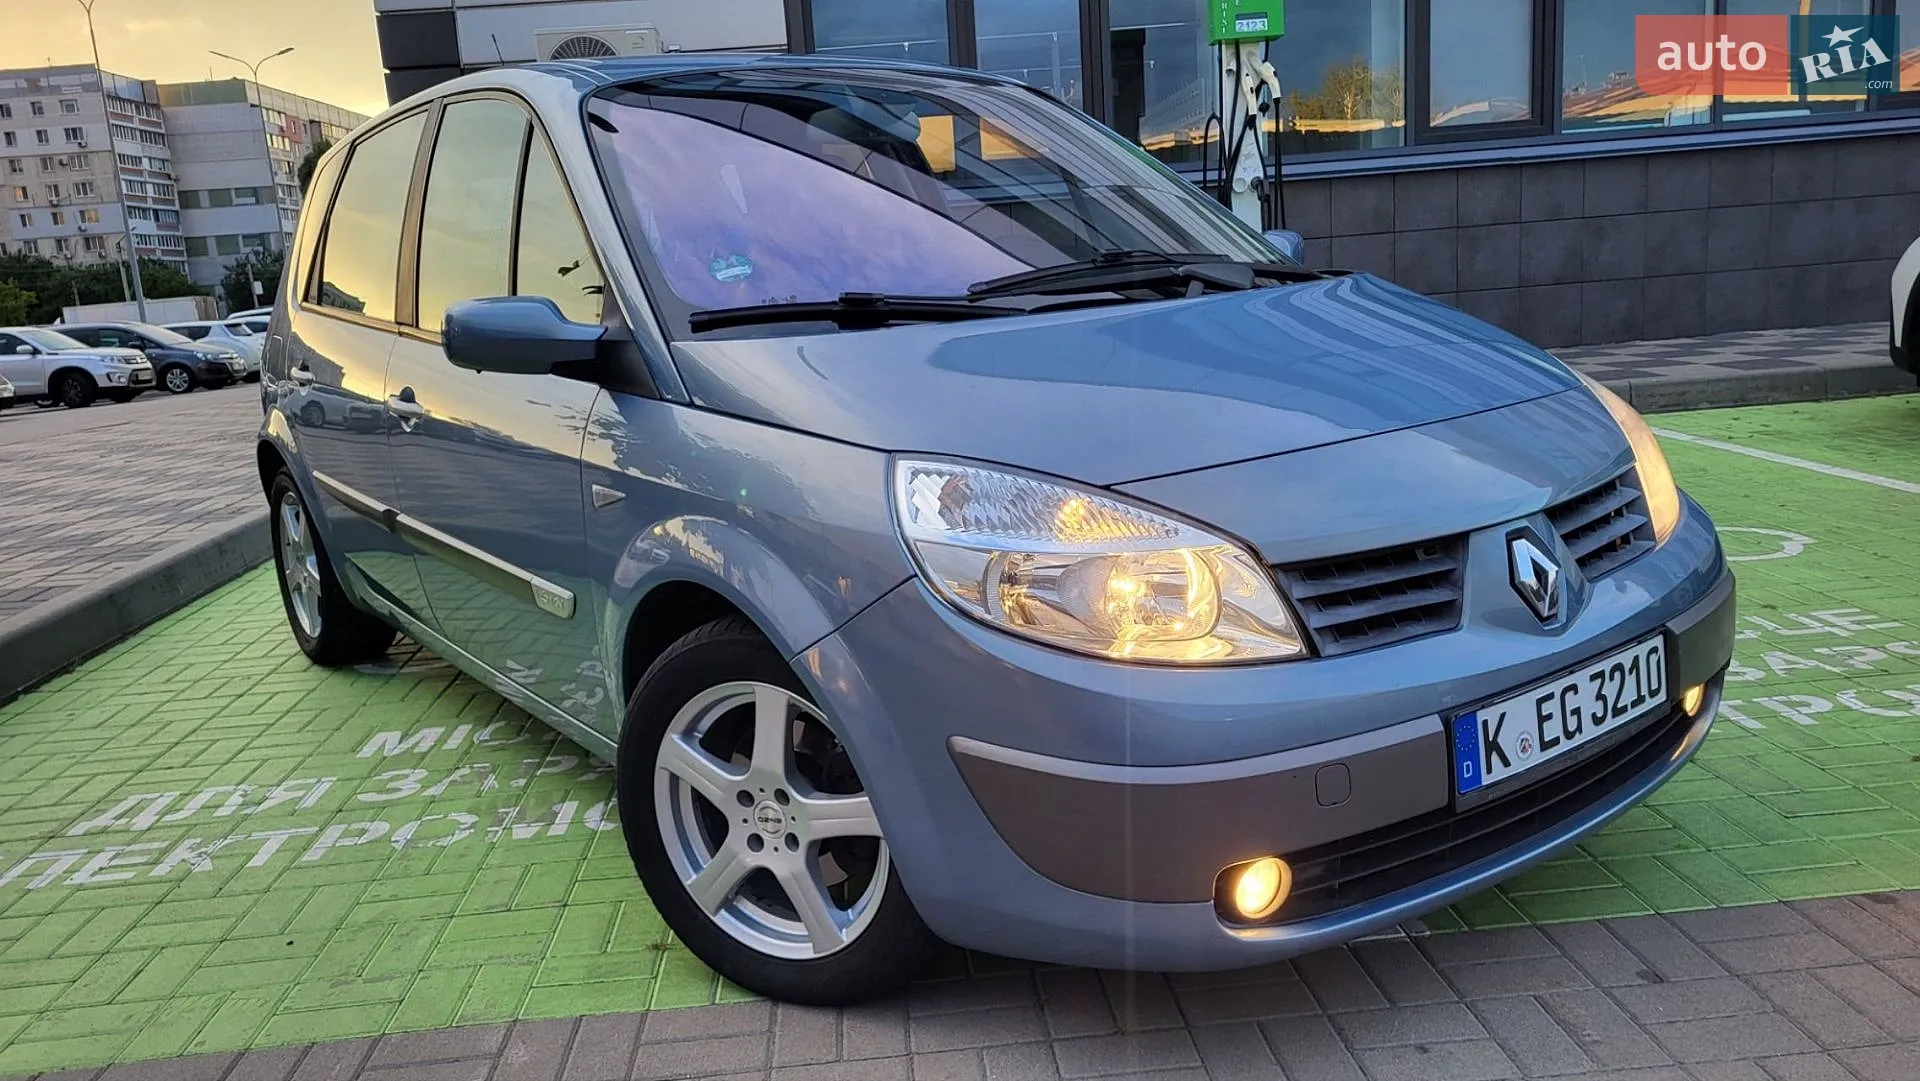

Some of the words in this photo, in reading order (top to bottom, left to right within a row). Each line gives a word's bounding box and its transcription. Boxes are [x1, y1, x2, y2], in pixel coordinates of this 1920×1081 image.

[1482, 711, 1512, 776] K
[1535, 683, 1583, 752] EG
[1589, 646, 1663, 727] 3210
[1463, 761, 1473, 778] D
[67, 777, 338, 837] ДЛЯ
